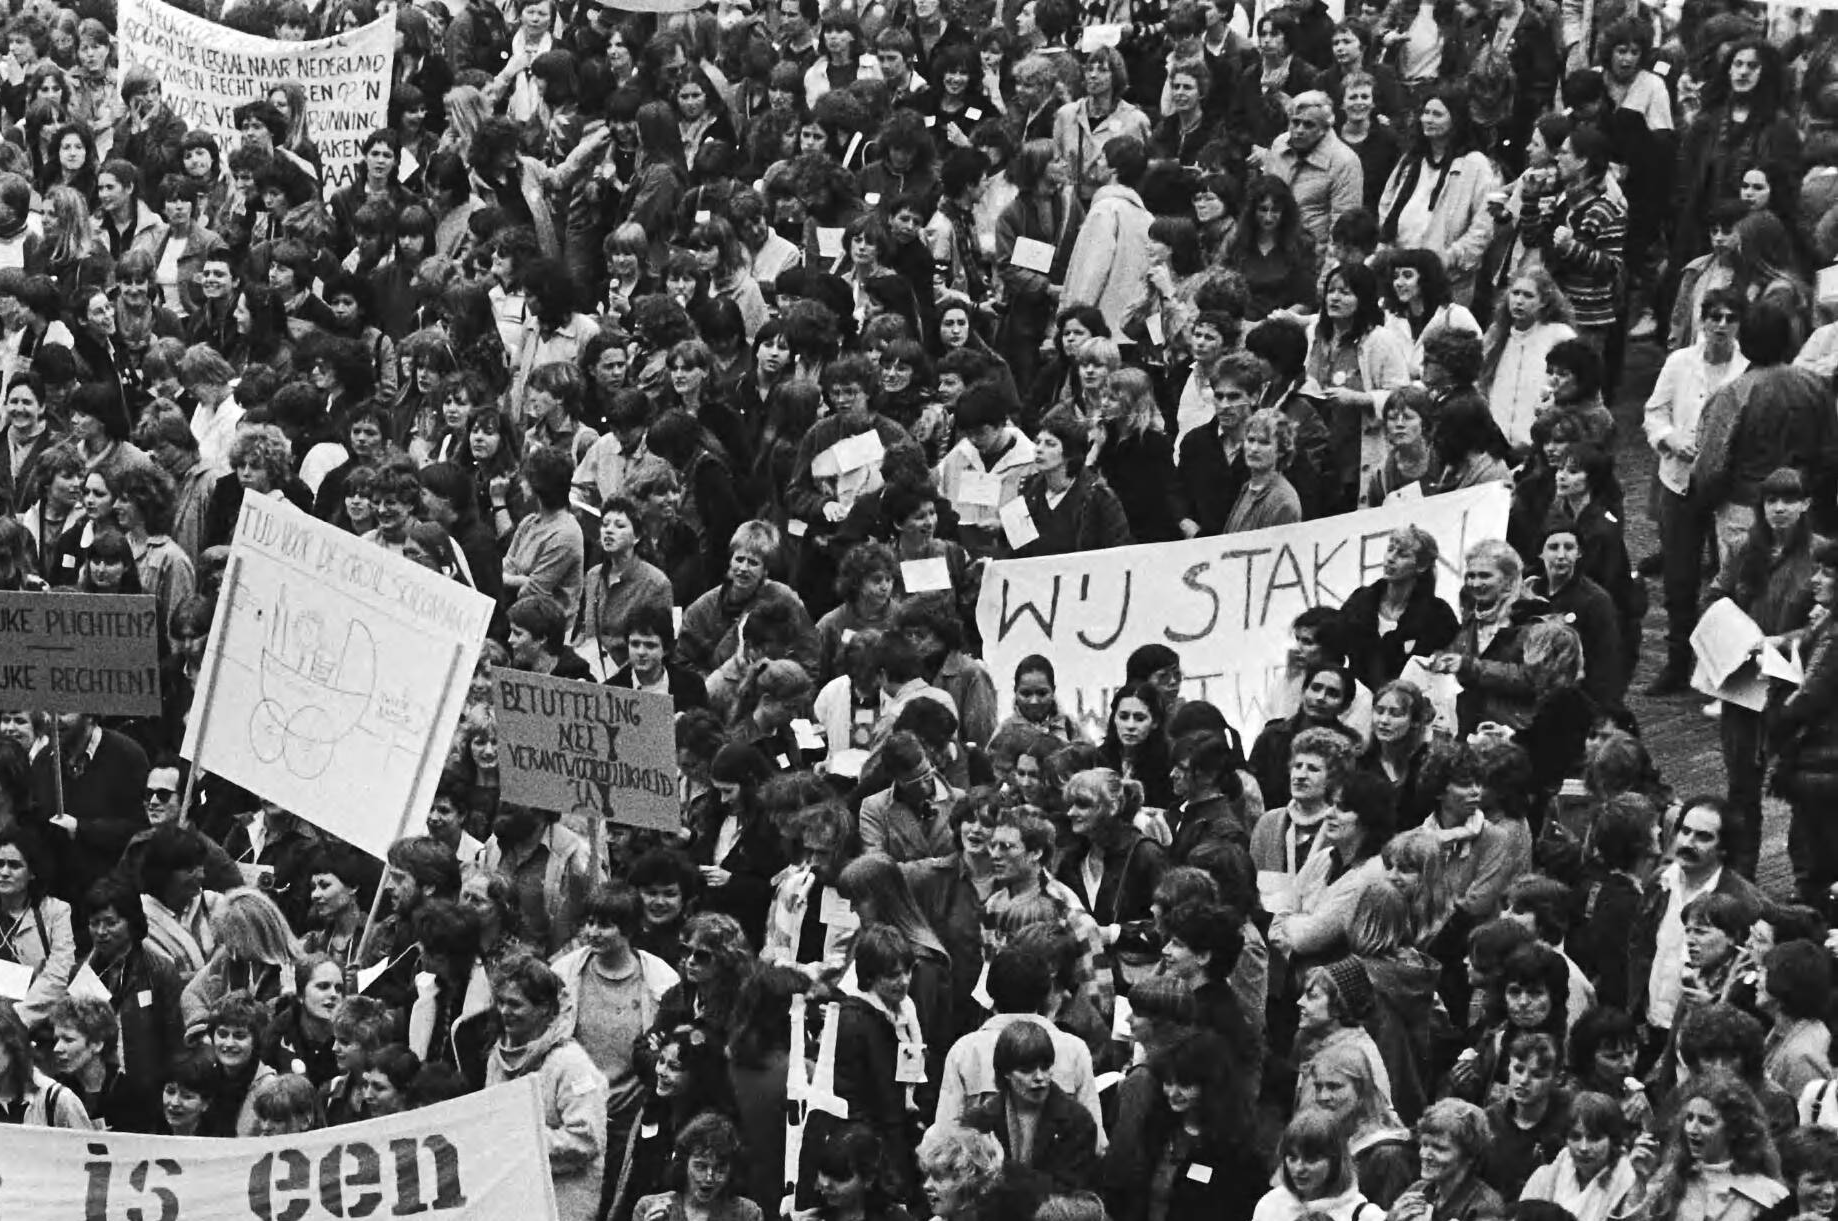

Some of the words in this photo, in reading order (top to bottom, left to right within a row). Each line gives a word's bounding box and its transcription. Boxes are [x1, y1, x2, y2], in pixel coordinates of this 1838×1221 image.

[297, 54, 386, 79] NEDERLAND
[210, 74, 254, 98] RECHT
[45, 608, 156, 640] PLICHTEN?
[50, 666, 157, 695] RECHTEN!
[500, 680, 642, 727] BETUTTELING
